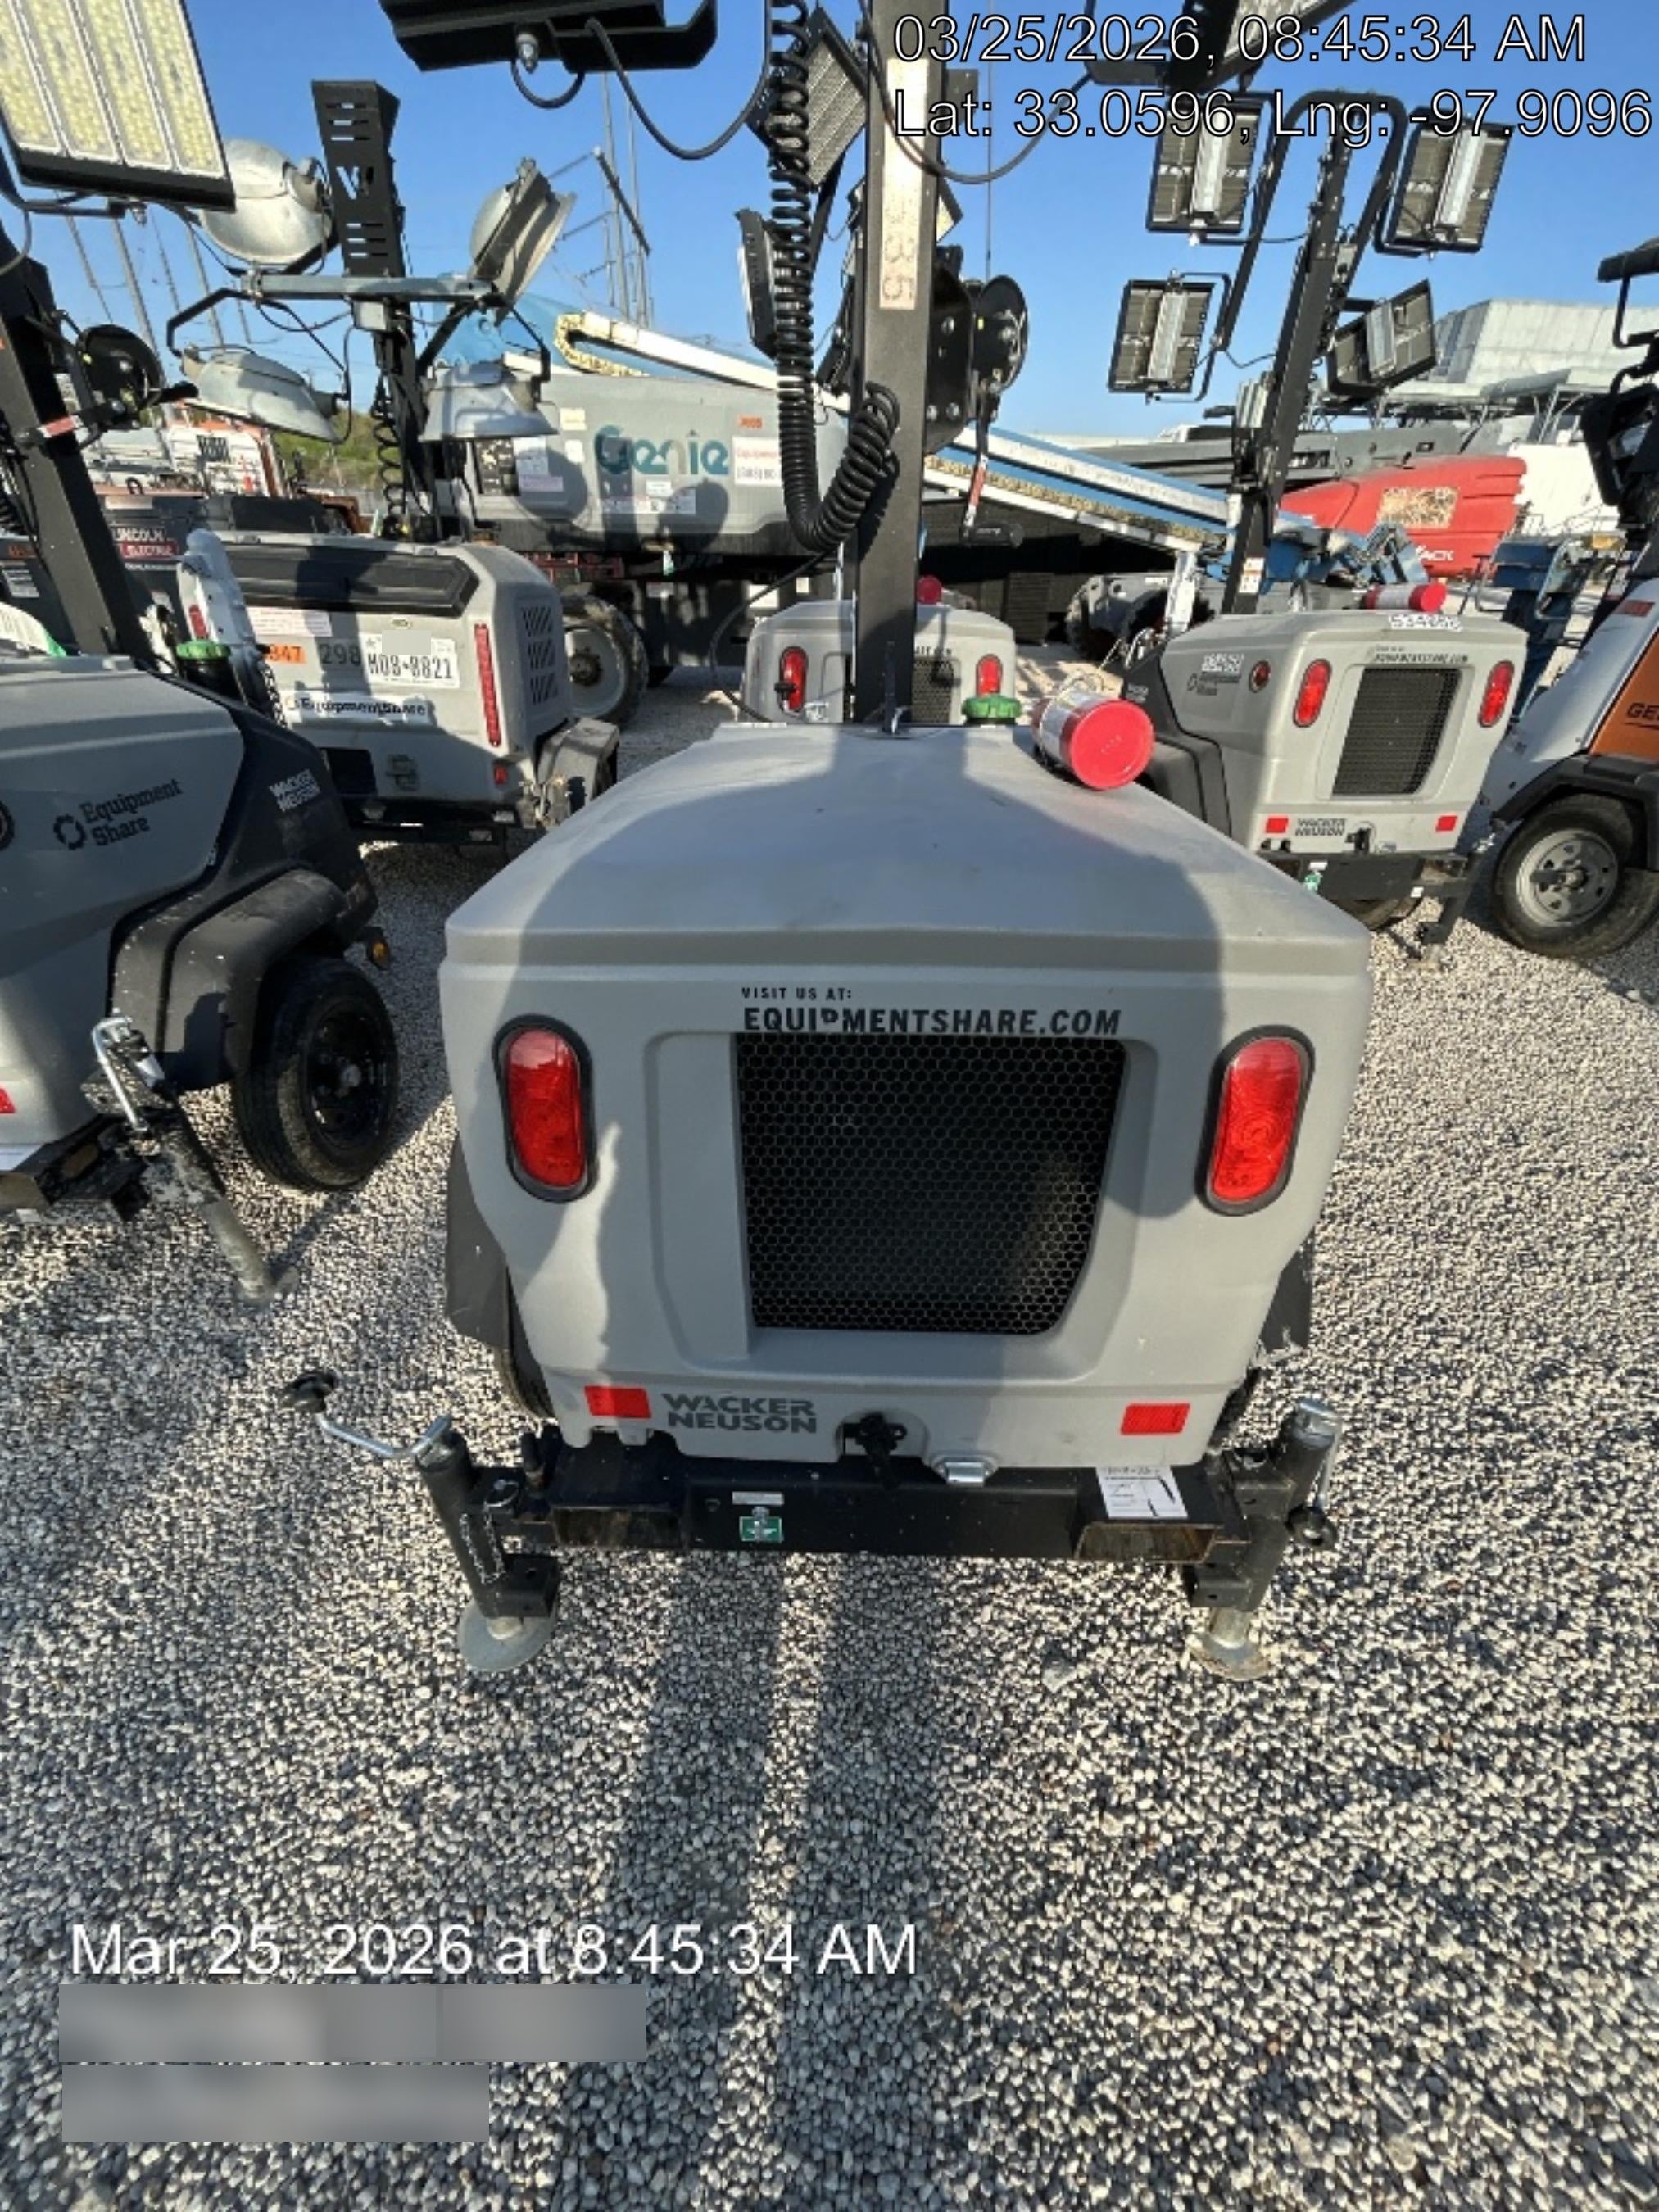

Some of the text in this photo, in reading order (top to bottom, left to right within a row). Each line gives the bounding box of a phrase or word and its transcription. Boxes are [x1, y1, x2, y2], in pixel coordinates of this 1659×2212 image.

[595, 424, 729, 475] Genie
[1626, 702, 1659, 723] GE
[79, 779, 183, 823] Equipment
[92, 817, 151, 846] Share
[741, 987, 852, 1001] VISIT US AT:
[744, 1007, 1122, 1036] EQUIPMENTSHARE.COM
[662, 1393, 817, 1416] WACKER
[668, 1412, 817, 1434] NEUSON
